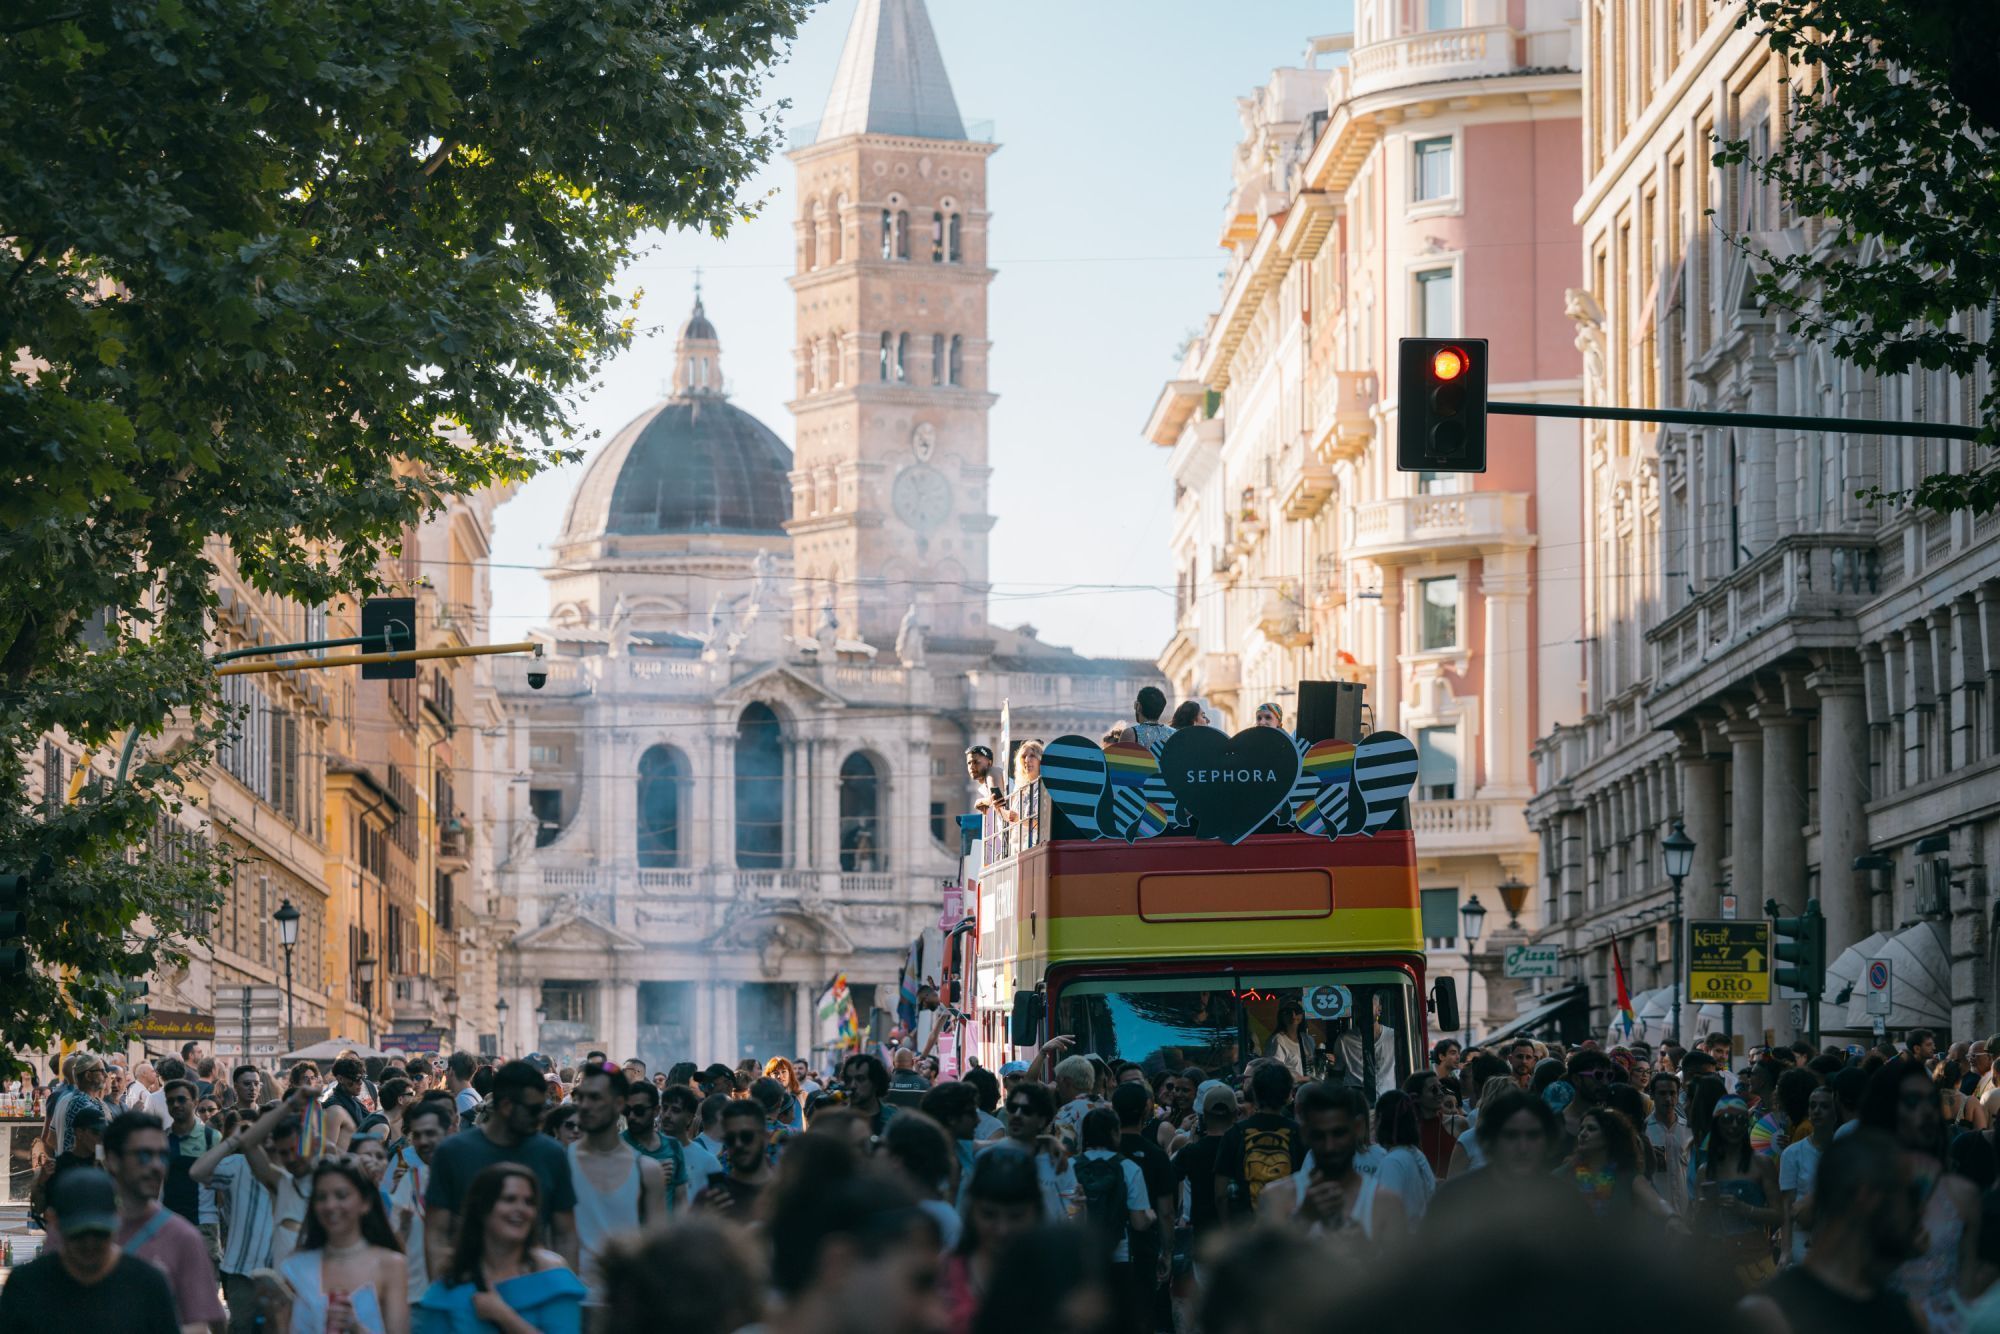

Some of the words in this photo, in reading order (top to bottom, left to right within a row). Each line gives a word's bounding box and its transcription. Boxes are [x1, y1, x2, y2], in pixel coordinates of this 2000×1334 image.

[1186, 769, 1277, 783] SEPHORA
[1508, 946, 1555, 965] Pizza
[1719, 947, 1730, 959] 7
[1706, 978, 1753, 991] ORO
[1316, 994, 1339, 1010] 32
[1693, 991, 1744, 999] ARGENTO
[146, 1020, 180, 1034] Scoglio
[182, 1022, 192, 1032] di
